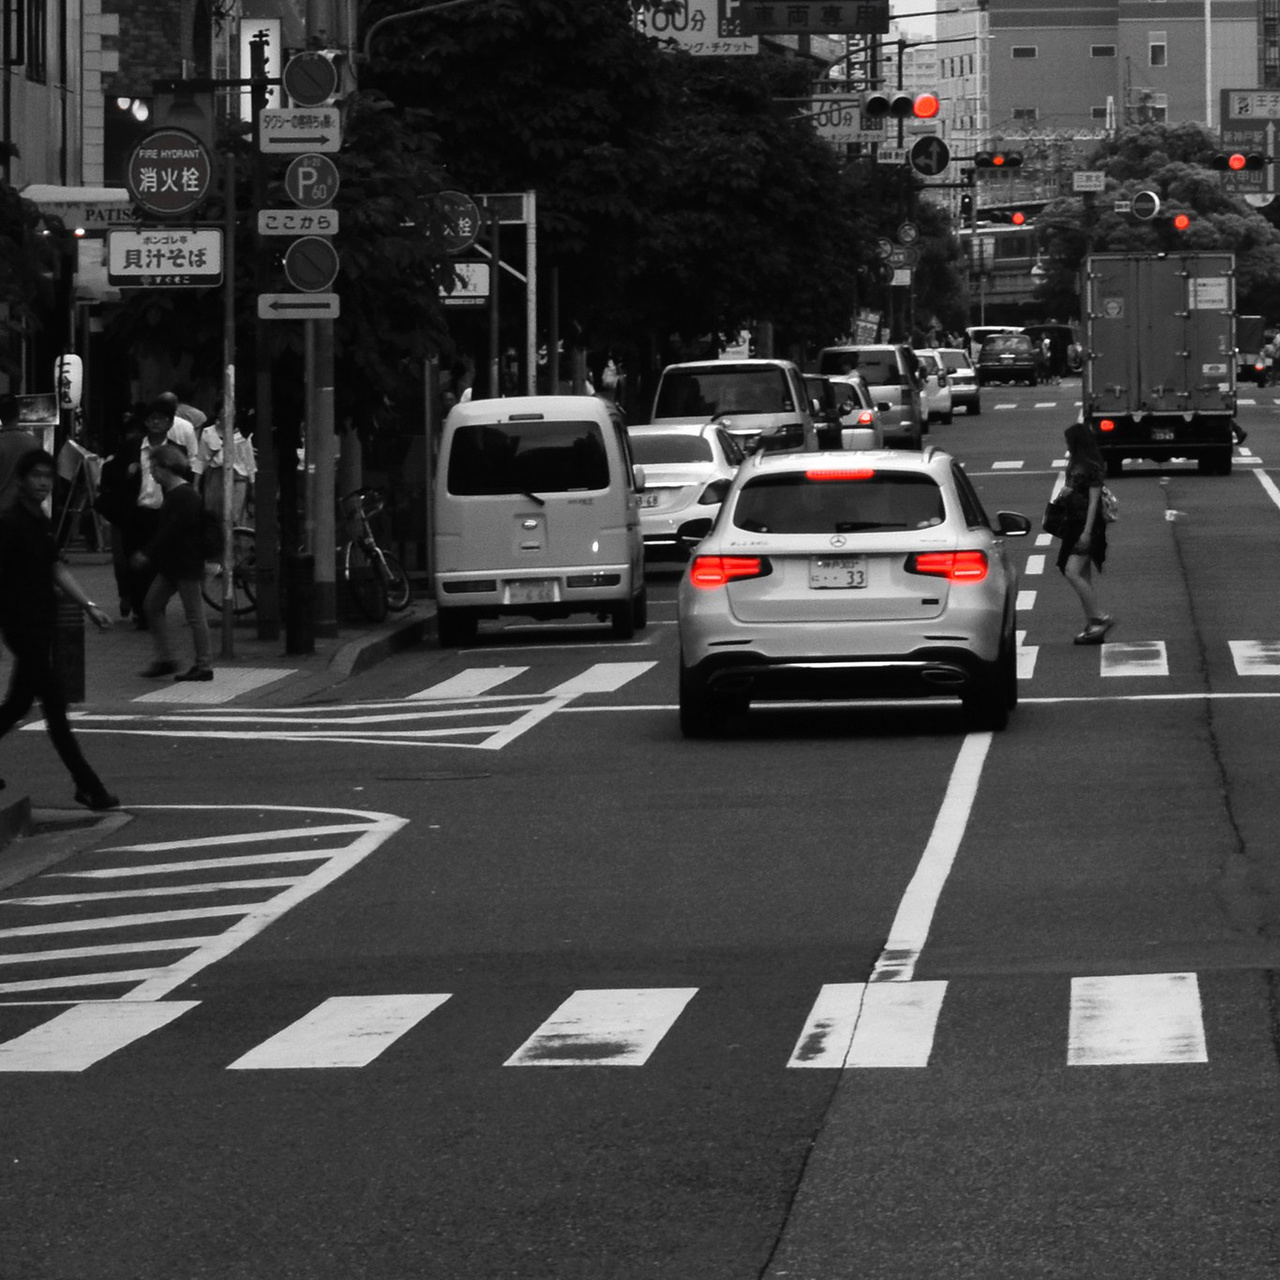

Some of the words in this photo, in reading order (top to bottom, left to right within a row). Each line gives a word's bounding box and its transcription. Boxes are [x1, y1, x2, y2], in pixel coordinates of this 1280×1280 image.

[752, 4, 877, 30] 車両専用
[139, 149, 158, 159] FIRE
[161, 149, 200, 159] HYDRANT
[138, 166, 200, 193] 消火栓
[298, 167, 318, 200] P
[265, 215, 332, 230] ここから
[123, 247, 208, 270] 貝汁そば
[155, 275, 191, 284] すぐそこ
